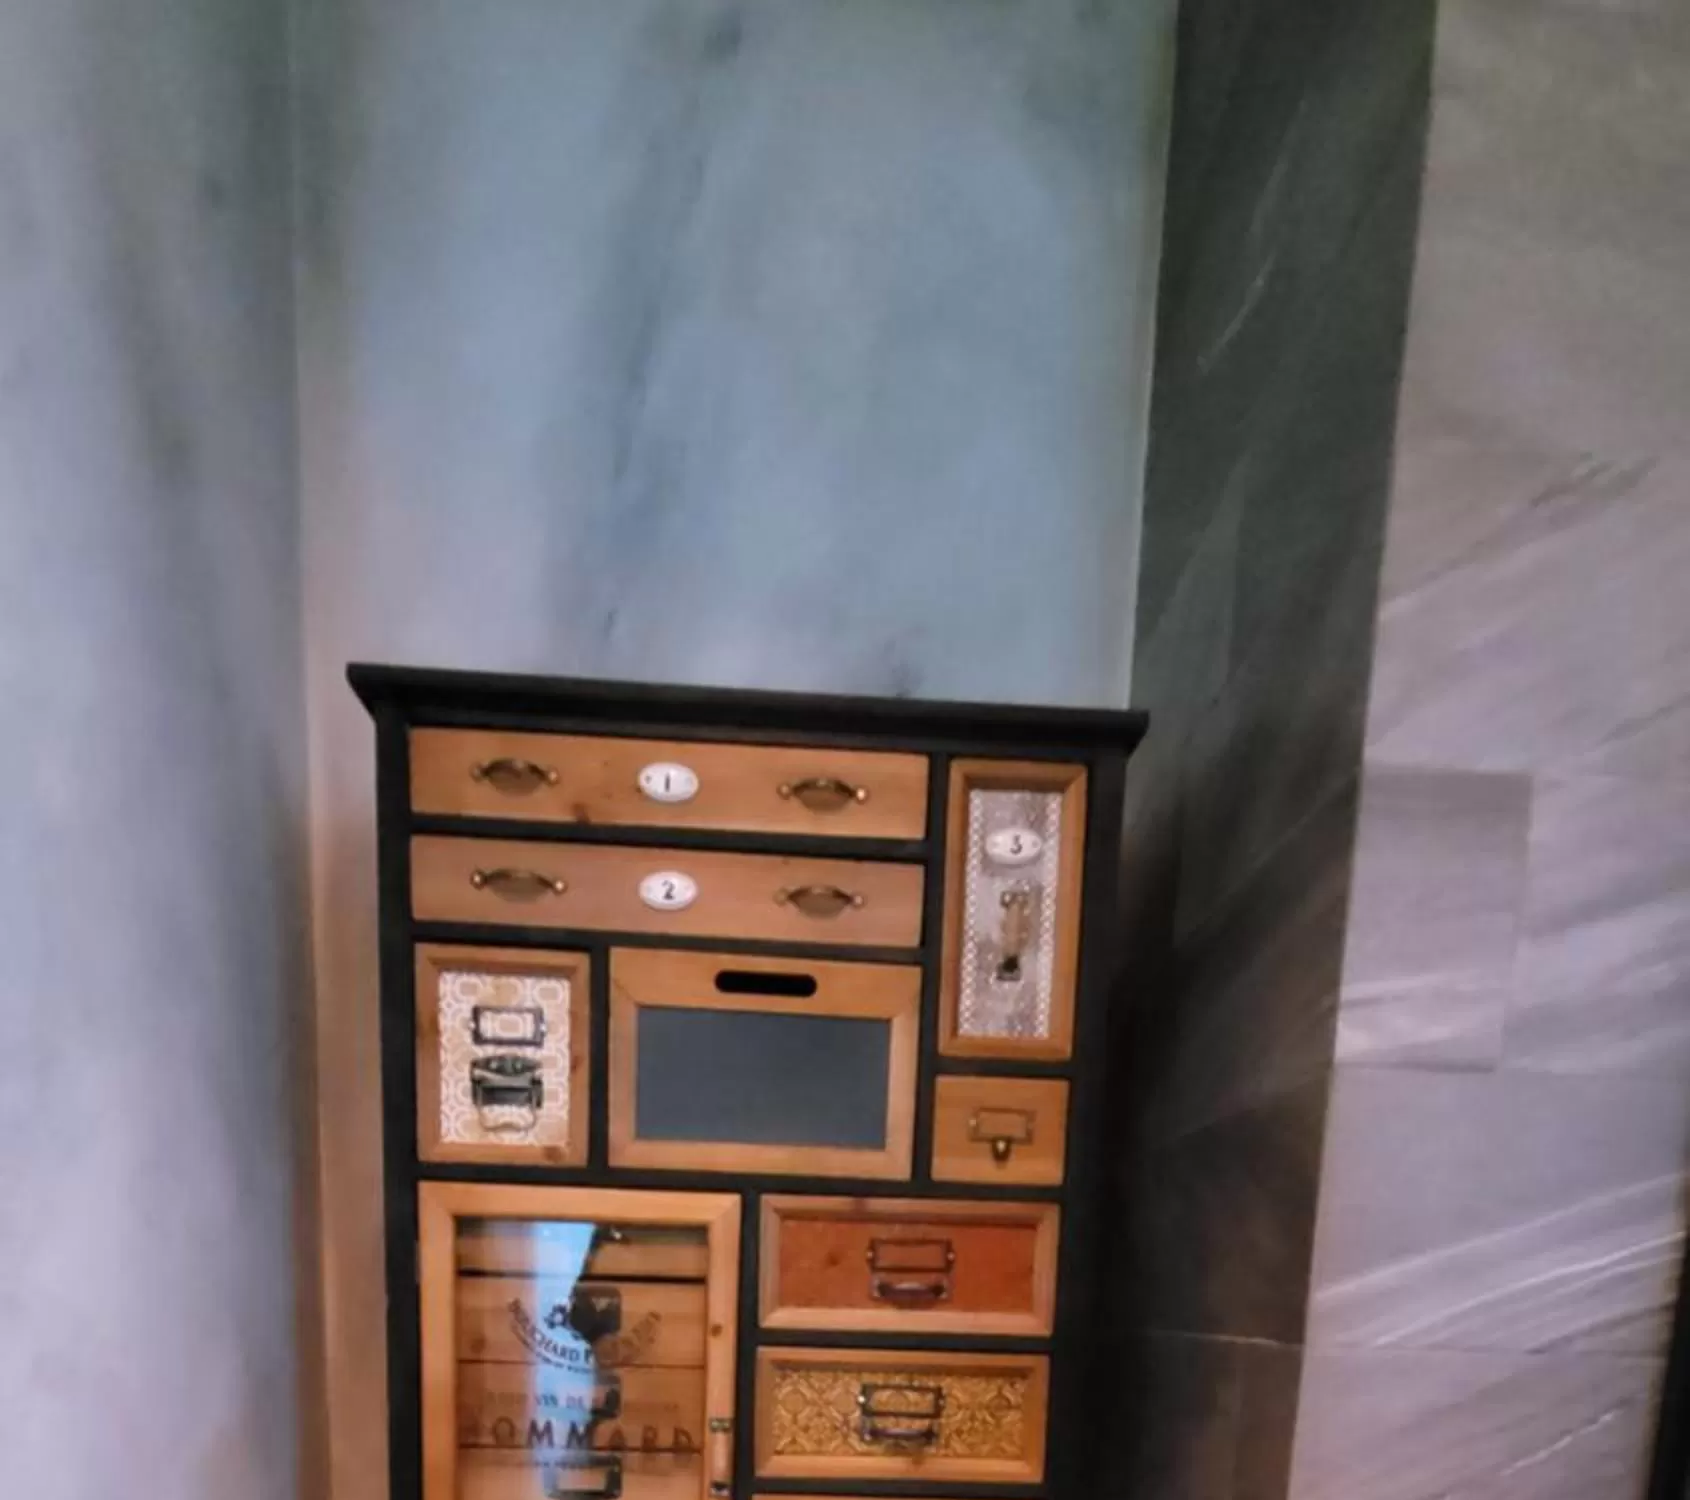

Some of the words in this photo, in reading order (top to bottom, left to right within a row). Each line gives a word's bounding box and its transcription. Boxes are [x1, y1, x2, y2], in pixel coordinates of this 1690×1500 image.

[663, 772, 671, 793] 1
[1009, 834, 1024, 856] 3
[661, 879, 676, 901] 2
